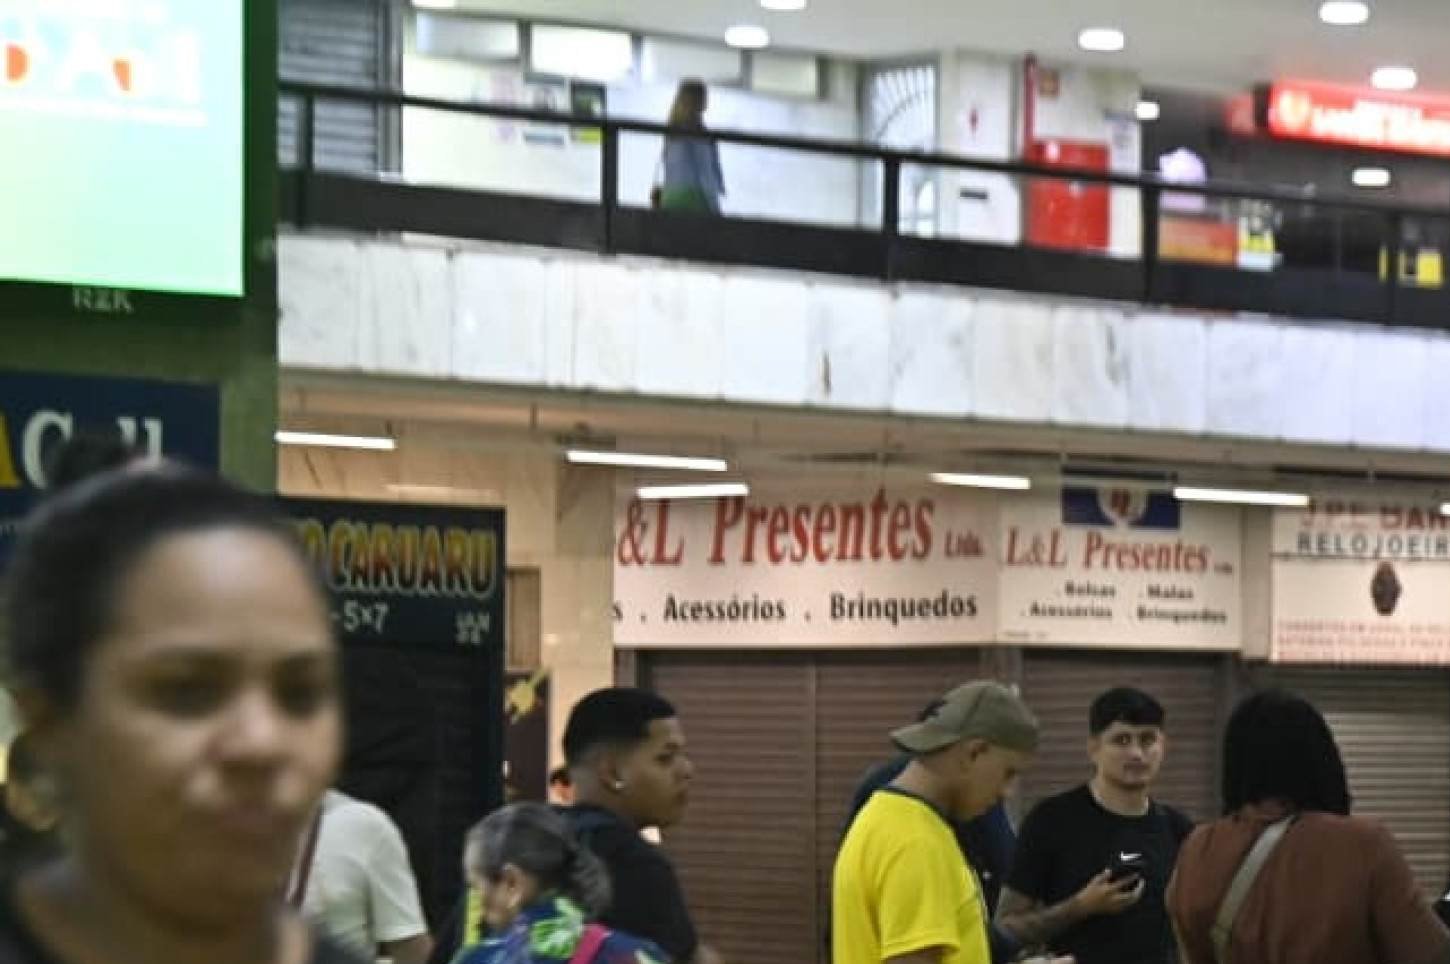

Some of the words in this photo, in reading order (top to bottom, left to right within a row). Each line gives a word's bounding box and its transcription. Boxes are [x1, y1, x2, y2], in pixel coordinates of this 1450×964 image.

[708, 484, 934, 565] Presentes
[1005, 526, 1067, 567] L&L
[1082, 530, 1213, 575] Presentes
[328, 518, 497, 598] CARUARU
[663, 592, 787, 621] Acessórios
[830, 590, 979, 629] Brinquedos
